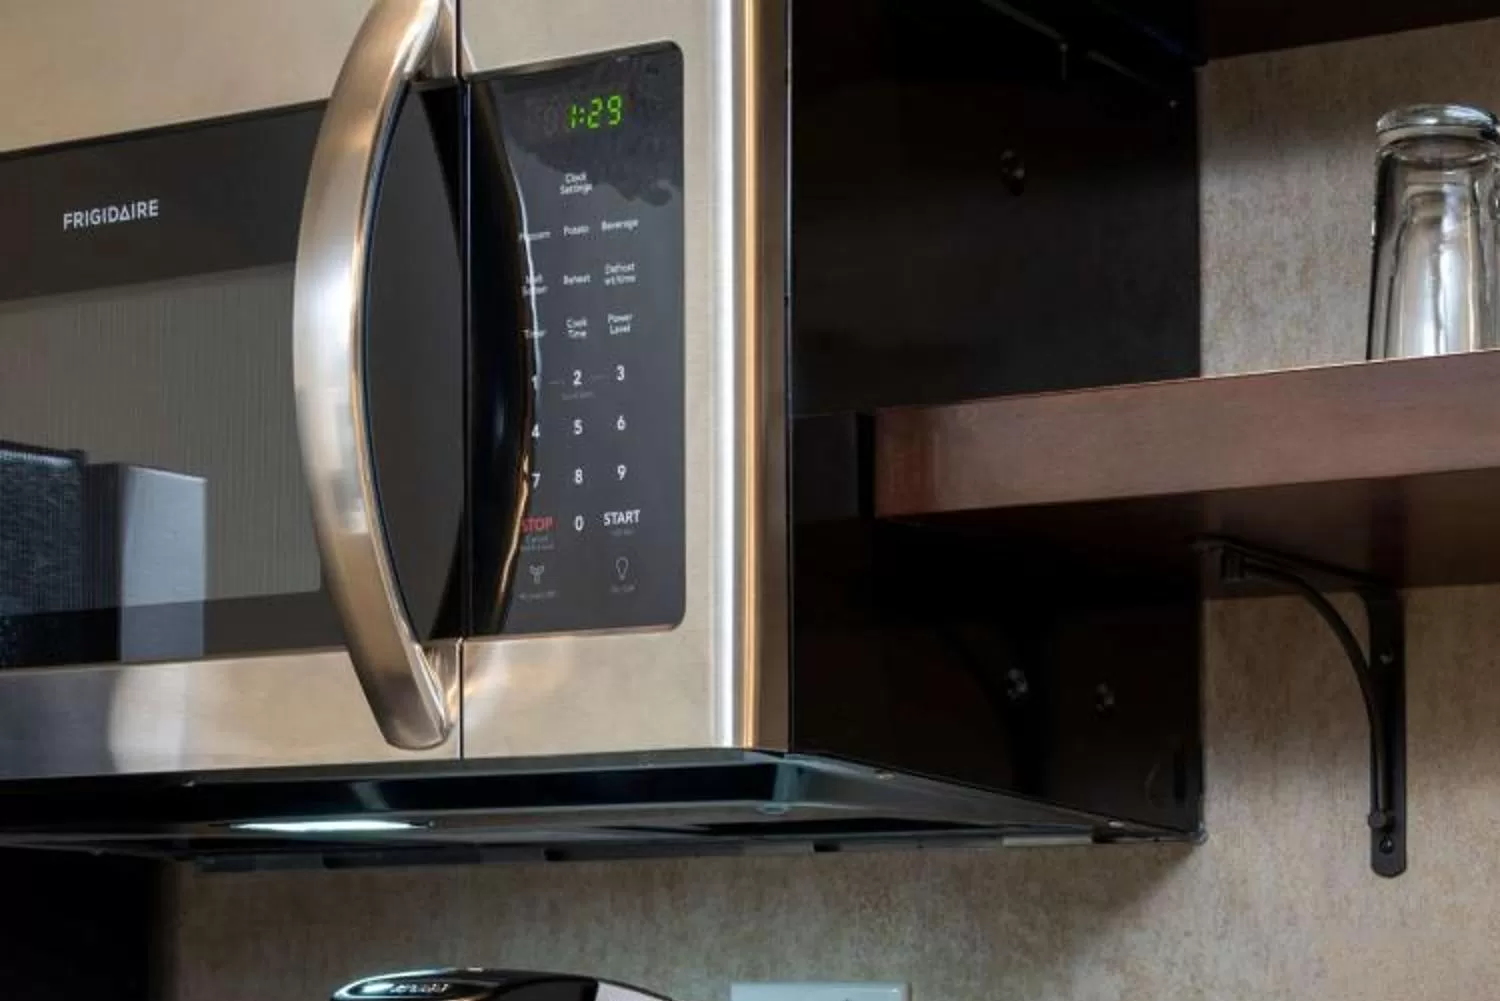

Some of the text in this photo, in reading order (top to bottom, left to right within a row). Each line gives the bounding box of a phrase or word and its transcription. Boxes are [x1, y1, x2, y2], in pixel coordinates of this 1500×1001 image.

[569, 95, 622, 129] 1:29
[63, 199, 159, 230] FRIGIDAIRE
[601, 219, 639, 231] Beverage
[573, 370, 583, 386] 2
[616, 364, 626, 381] 3
[531, 423, 541, 438] 4
[573, 419, 583, 435] 5
[616, 415, 626, 431] 6
[574, 468, 584, 485] 8
[617, 464, 627, 480] 9
[532, 473, 541, 488] 7
[522, 516, 555, 533] STOP
[575, 515, 585, 532] 0
[603, 509, 641, 527] START
